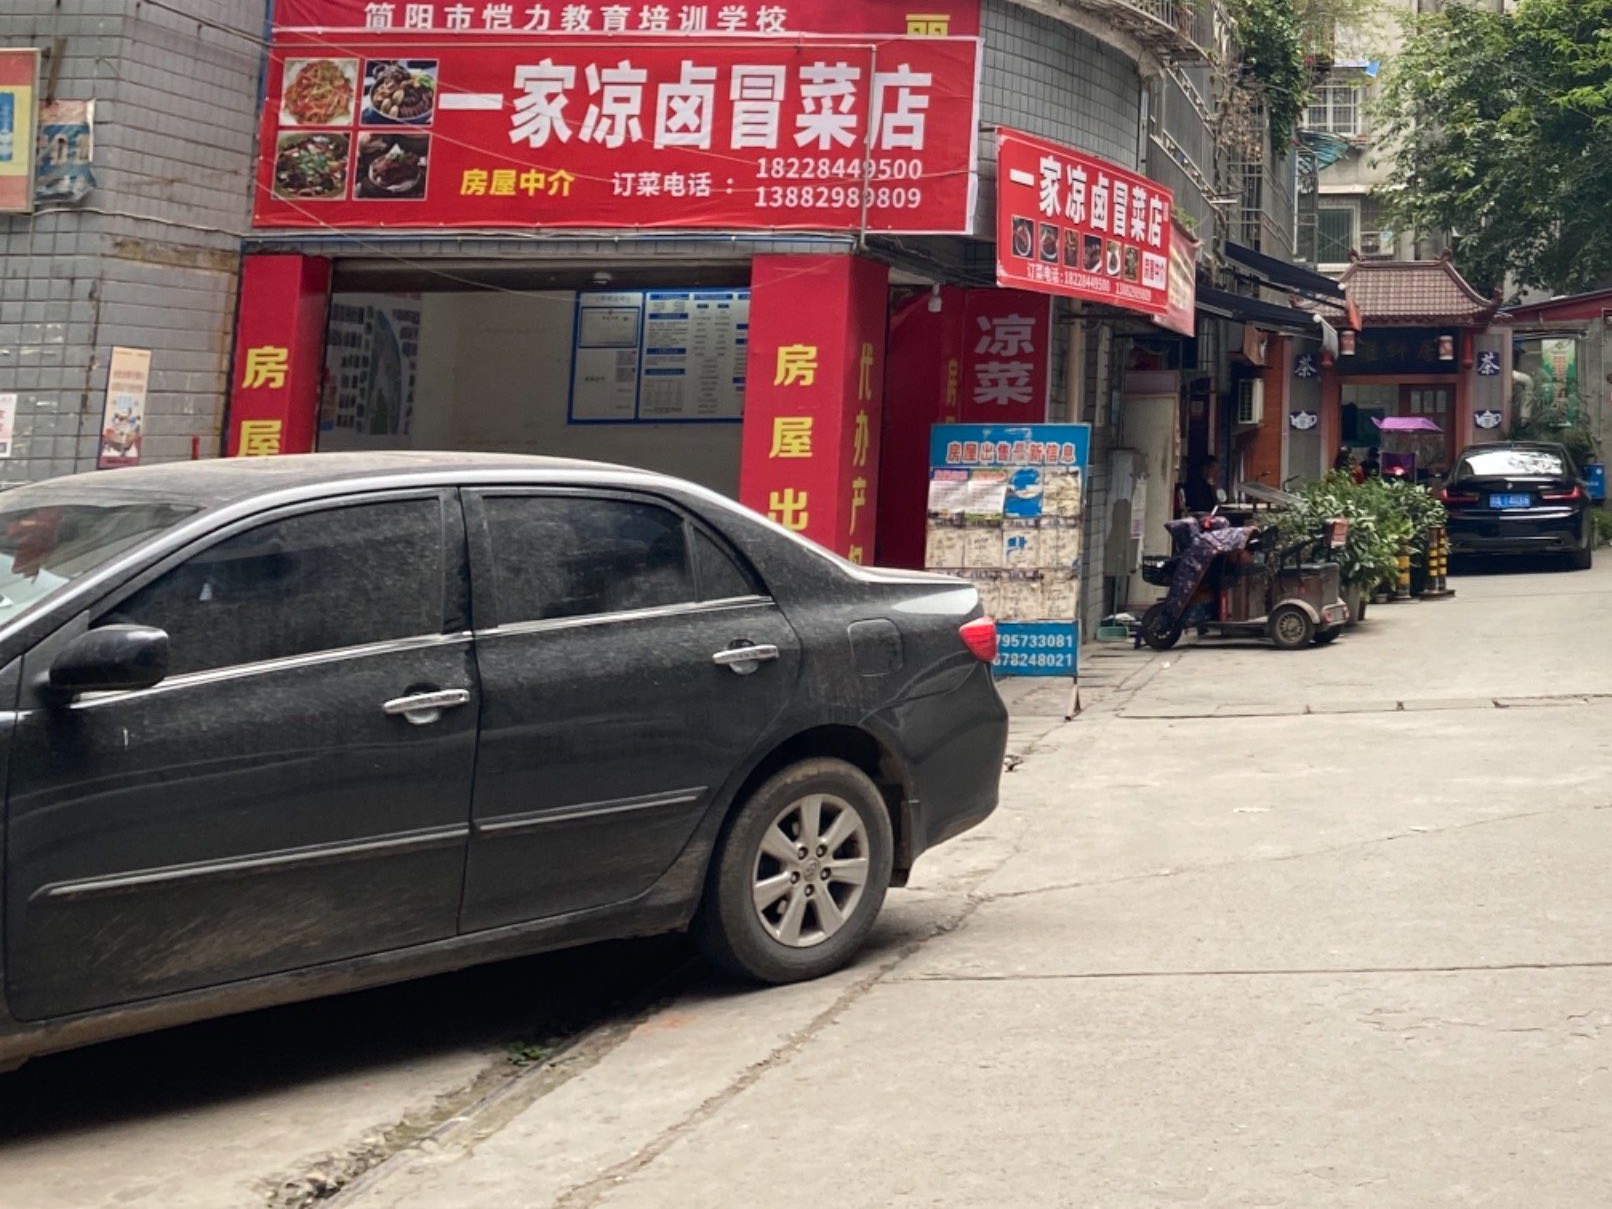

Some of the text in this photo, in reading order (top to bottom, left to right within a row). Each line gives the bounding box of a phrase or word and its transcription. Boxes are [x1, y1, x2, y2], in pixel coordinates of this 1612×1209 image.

[364, 2, 789, 34] 简阳市恺力教育培训学校
[438, 57, 933, 152] 一家凉卤冒菜店
[459, 168, 576, 198] 房屋中介
[755, 157, 923, 180] 18228449500
[754, 186, 922, 209] 13882989809
[1009, 155, 1162, 249] 一家凉卤冒菜店
[972, 313, 1037, 406] 凉菜
[1478, 352, 1501, 375] 茶
